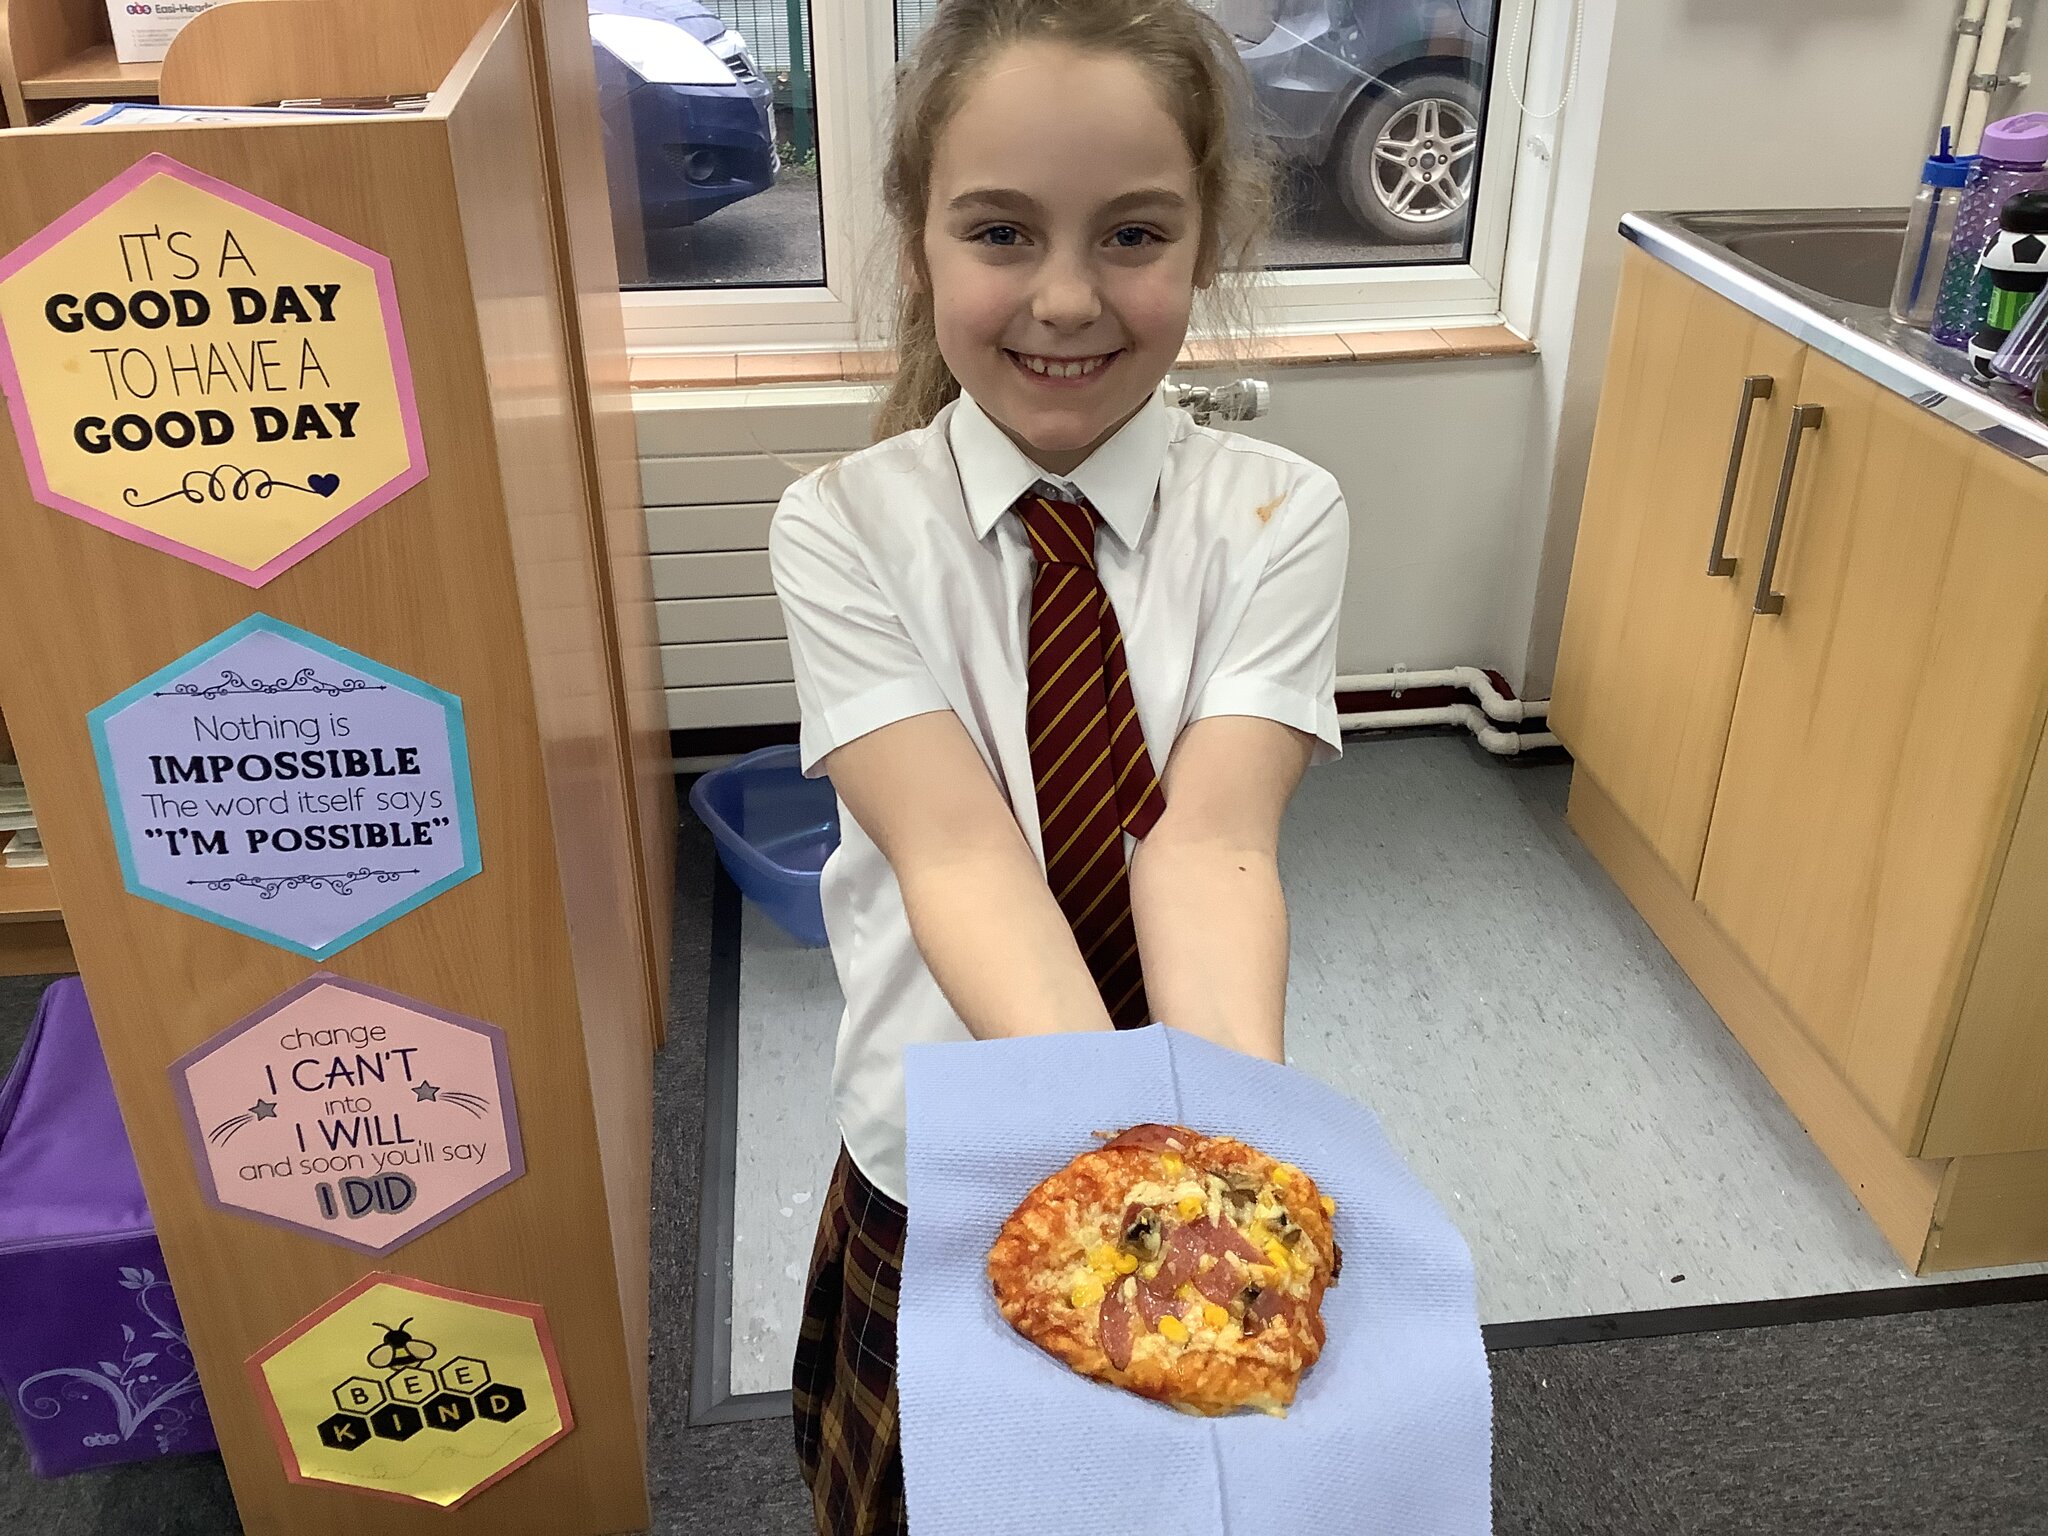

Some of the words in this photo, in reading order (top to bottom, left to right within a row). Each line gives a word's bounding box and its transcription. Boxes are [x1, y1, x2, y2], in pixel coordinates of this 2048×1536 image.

[119, 224, 200, 281] IT'S
[218, 229, 256, 277] A
[45, 289, 211, 333] GOOD
[227, 284, 341, 325] DAY
[90, 347, 157, 399] TO
[166, 341, 287, 396] HAVE
[300, 338, 330, 389] A
[74, 409, 234, 454] GOOD
[250, 402, 360, 442] DAY
[193, 714, 320, 744] Nothing
[330, 713, 350, 737] is
[149, 747, 421, 784] IMPOSSIBLE
[142, 793, 198, 819] The
[206, 790, 289, 817] word
[298, 788, 365, 813] itself
[377, 789, 442, 816] says
[280, 1025, 386, 1050] change
[266, 1065, 277, 1095] I
[292, 1048, 418, 1091] CAN'T
[325, 1097, 372, 1116] into
[296, 1123, 305, 1152] I
[318, 1114, 415, 1152] WILL
[239, 1157, 292, 1180] and
[300, 1153, 364, 1175] soon
[371, 1140, 434, 1174] you'll
[442, 1143, 487, 1165] say
[322, 1187, 332, 1215] I
[346, 1176, 412, 1215] DID
[353, 1366, 472, 1405] BEE
[333, 1394, 509, 1441] KIND
